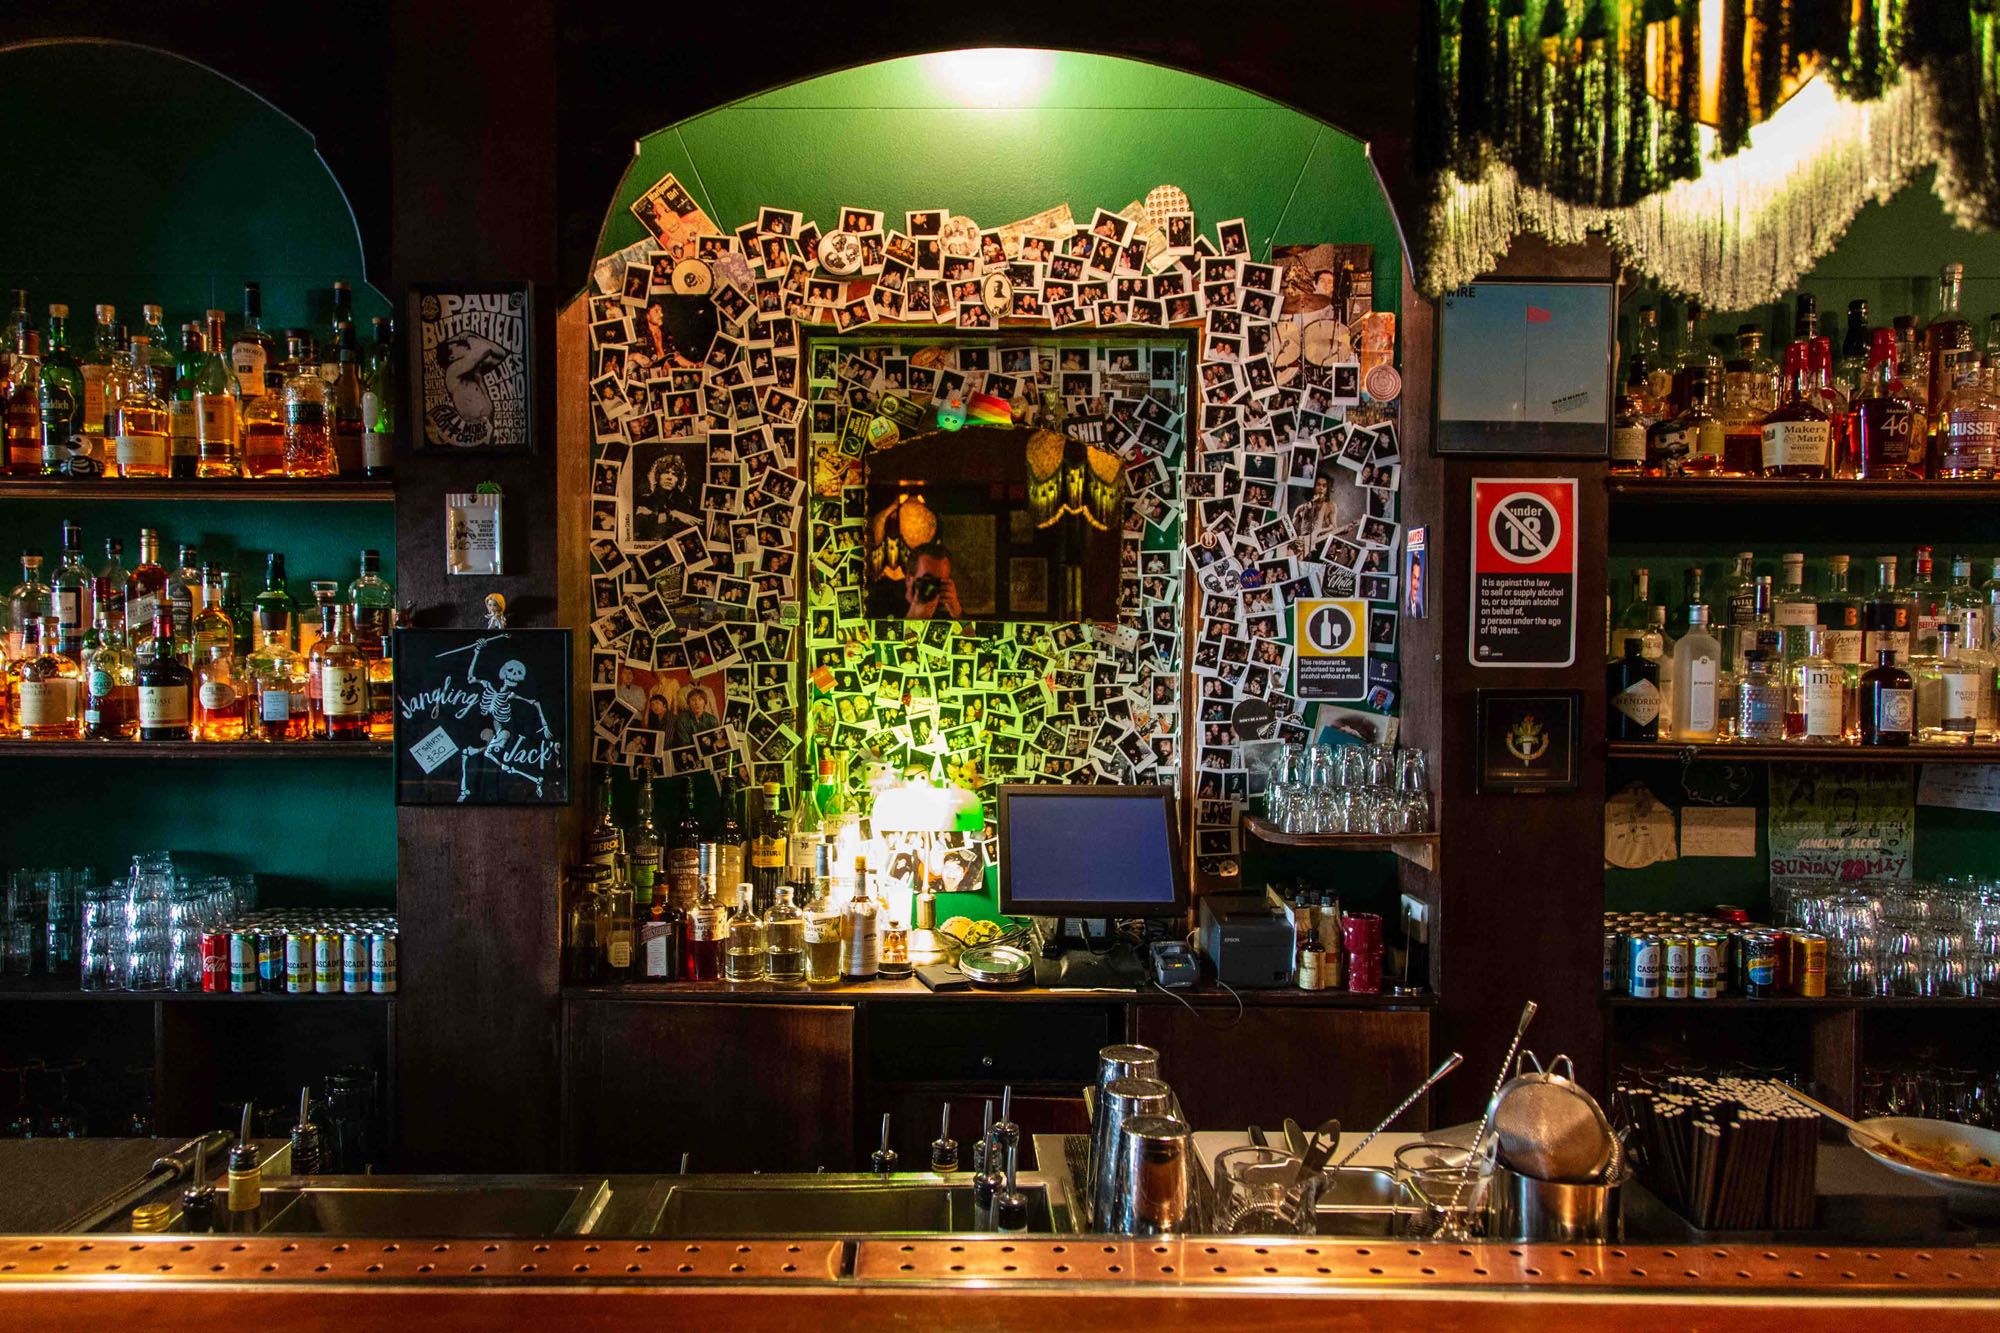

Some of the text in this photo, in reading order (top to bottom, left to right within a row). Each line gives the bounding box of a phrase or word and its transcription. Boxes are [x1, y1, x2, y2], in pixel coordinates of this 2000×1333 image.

[1446, 287, 1476, 298] WIRE
[437, 294, 522, 318] PAUL
[422, 312, 524, 354] BUTTERFIELD
[484, 354, 524, 386] BLUES
[487, 373, 525, 401] BAND
[494, 419, 526, 428] MARCH
[1880, 414, 1908, 436] 46
[1068, 421, 1103, 442] SHIT
[1784, 425, 1827, 434] Maker's
[1797, 435, 1825, 443] Mark
[1510, 506, 1543, 516] under
[1505, 517, 1541, 550] 18
[1482, 579, 1550, 589] It is against the law
[1481, 588, 1489, 596] to
[1491, 588, 1502, 596] sell
[1513, 588, 1536, 598] supply
[1538, 588, 1564, 596] alcohol
[1481, 598, 1490, 607] to,
[1501, 598, 1508, 606] to
[1509, 598, 1531, 606] obtain
[1533, 598, 1559, 606] alcohol
[1492, 607, 1514, 615] behalf
[1515, 607, 1524, 616] of,
[1487, 618, 1512, 627] person
[1513, 617, 1534, 625] under
[1535, 617, 1547, 625] the
[1548, 618, 1561, 627] age
[1498, 628, 1520, 636] years.
[398, 675, 480, 719] Jangling
[425, 745, 446, 763] $30
[503, 734, 561, 770] Jack's
[1797, 839, 1845, 849] JANGLING
[1771, 859, 1841, 876] SUNDAY
[1865, 857, 1908, 877] MAY
